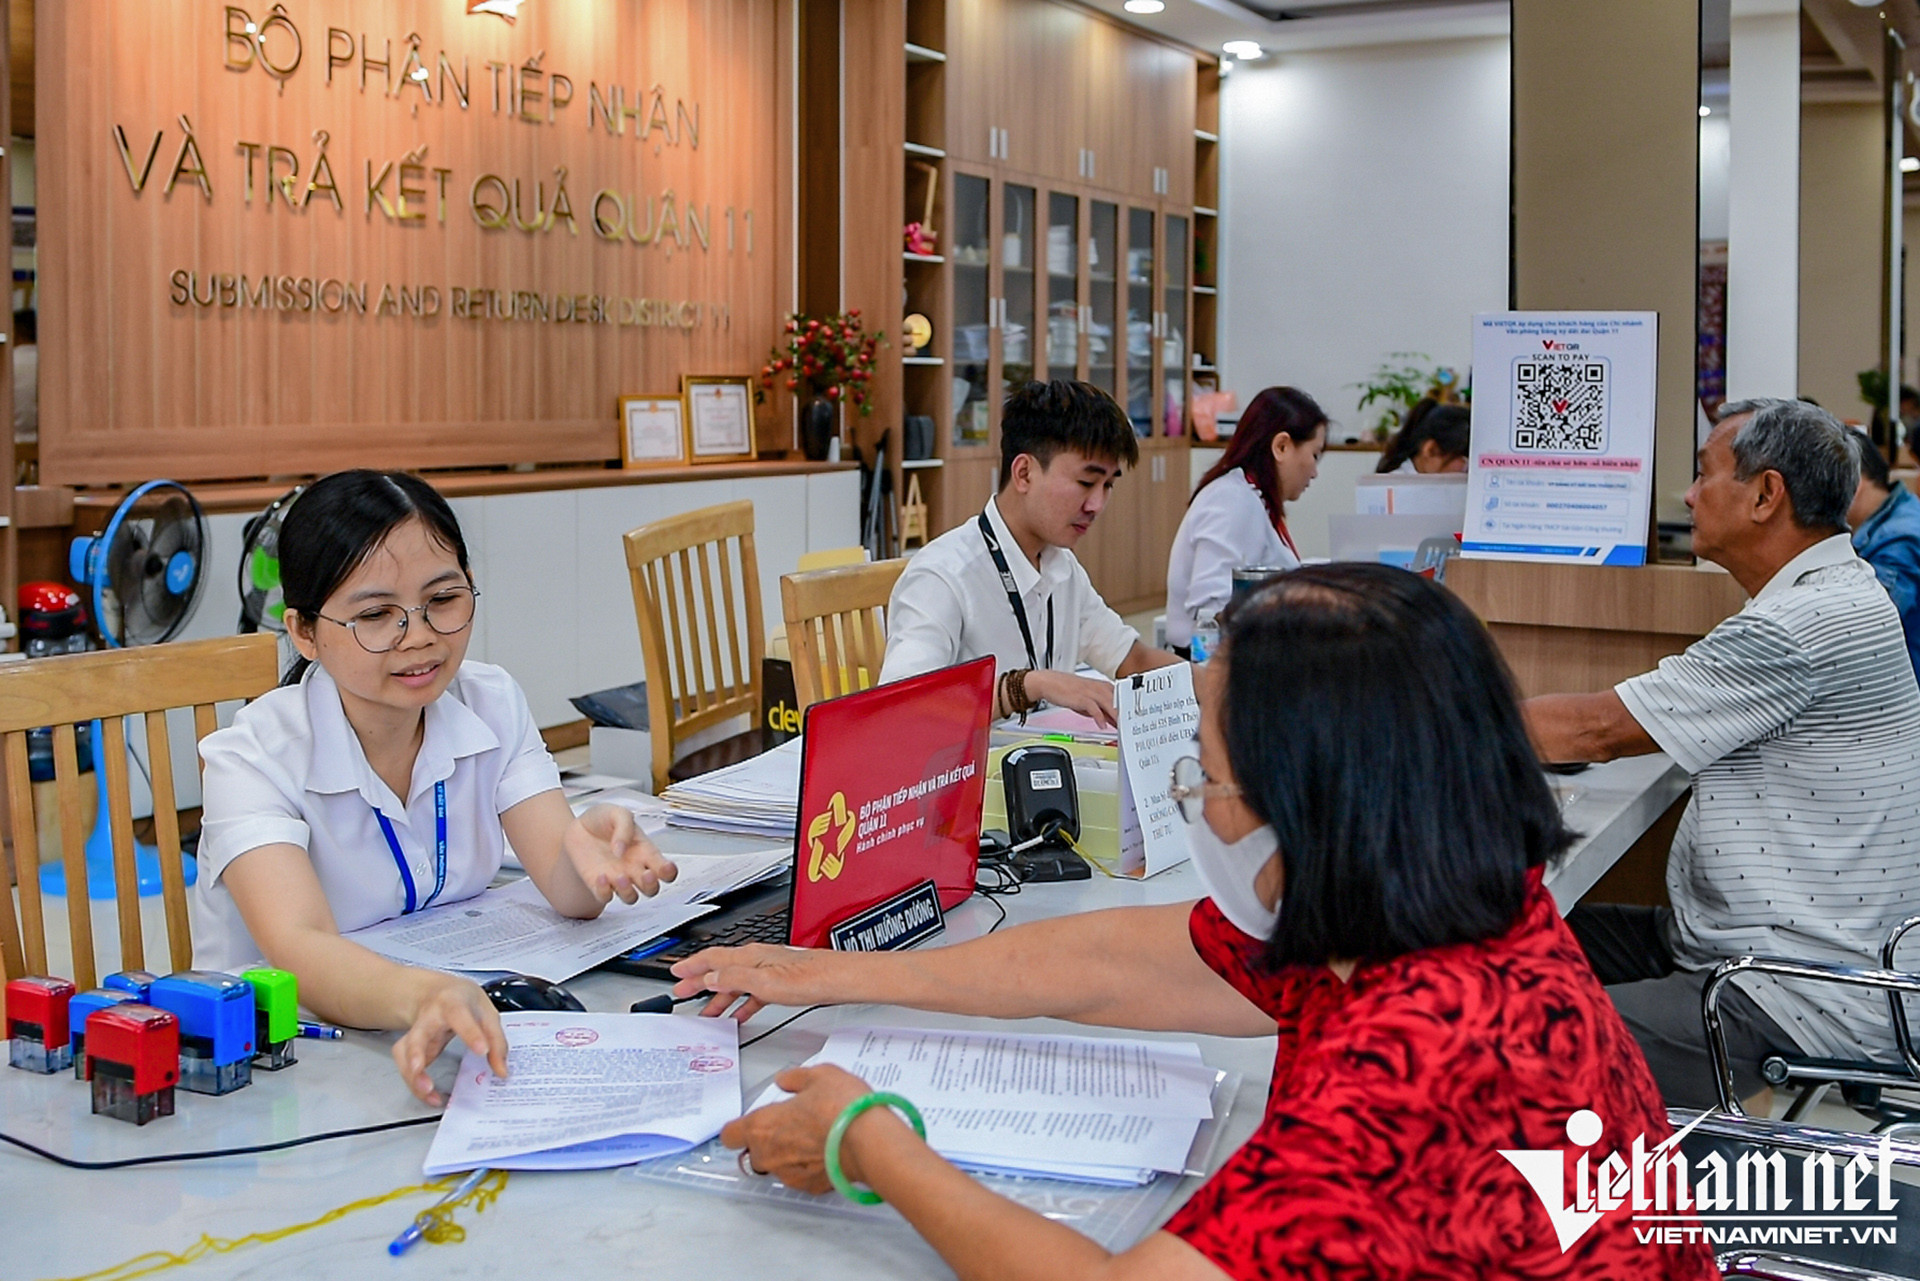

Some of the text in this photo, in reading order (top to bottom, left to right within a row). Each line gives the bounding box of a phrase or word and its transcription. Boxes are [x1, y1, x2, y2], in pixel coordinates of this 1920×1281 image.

[224, 2, 699, 156] BỘ PHẬN TIẾP NHẬN
[112, 114, 755, 259] VÀ TRẢ KẾT QUẢ QUẬN 11
[169, 269, 367, 315] SUBMISSION
[374, 283, 442, 318] AND
[449, 287, 549, 322] RETURN
[554, 293, 613, 324] DESK
[1542, 340, 1580, 351] VIETQR
[860, 759, 976, 821] BỘ PHẬN TIẾP NHẬN VÀ TRẢ KẾT QUẢ
[858, 811, 887, 839] QUẬN 11
[876, 828, 896, 845] chính
[897, 821, 915, 838] phục
[916, 816, 925, 829] vụ
